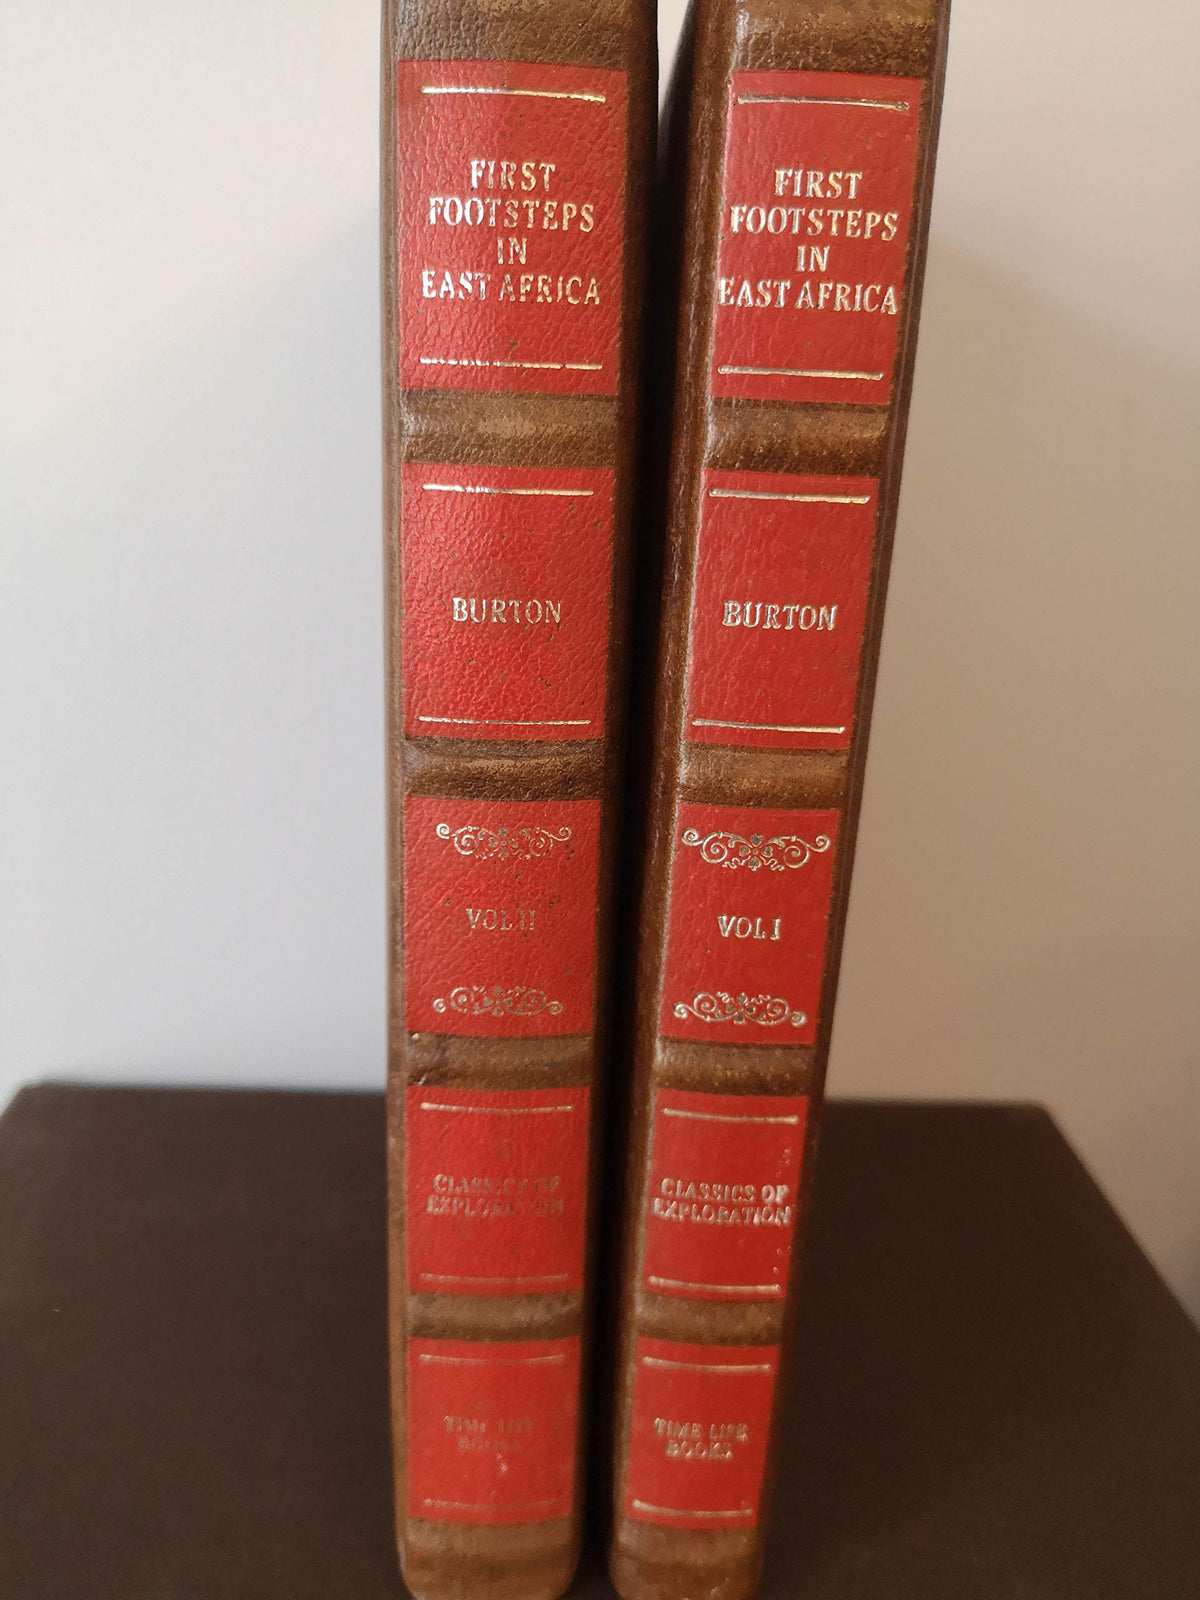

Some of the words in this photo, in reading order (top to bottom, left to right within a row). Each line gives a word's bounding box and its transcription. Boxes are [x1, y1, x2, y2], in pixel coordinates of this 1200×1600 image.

[470, 159, 556, 191] FIRST
[774, 168, 862, 199] FIRST
[428, 197, 595, 232] FOOTSTEPS
[730, 204, 898, 241] FOOTSTEPS
[497, 236, 528, 265] IN
[795, 245, 830, 272] IN
[421, 270, 491, 300] EAST
[498, 274, 600, 305] AFRICA
[717, 276, 791, 308] EAST
[794, 281, 898, 315] AFRICA
[452, 597, 561, 624] BURTON
[722, 600, 838, 631] BURTON
[466, 908, 513, 931] VOL
[660, 1177, 757, 1202] CLASSICS
[760, 1184, 790, 1205] OF
[651, 1197, 792, 1227] EXPLORATION
